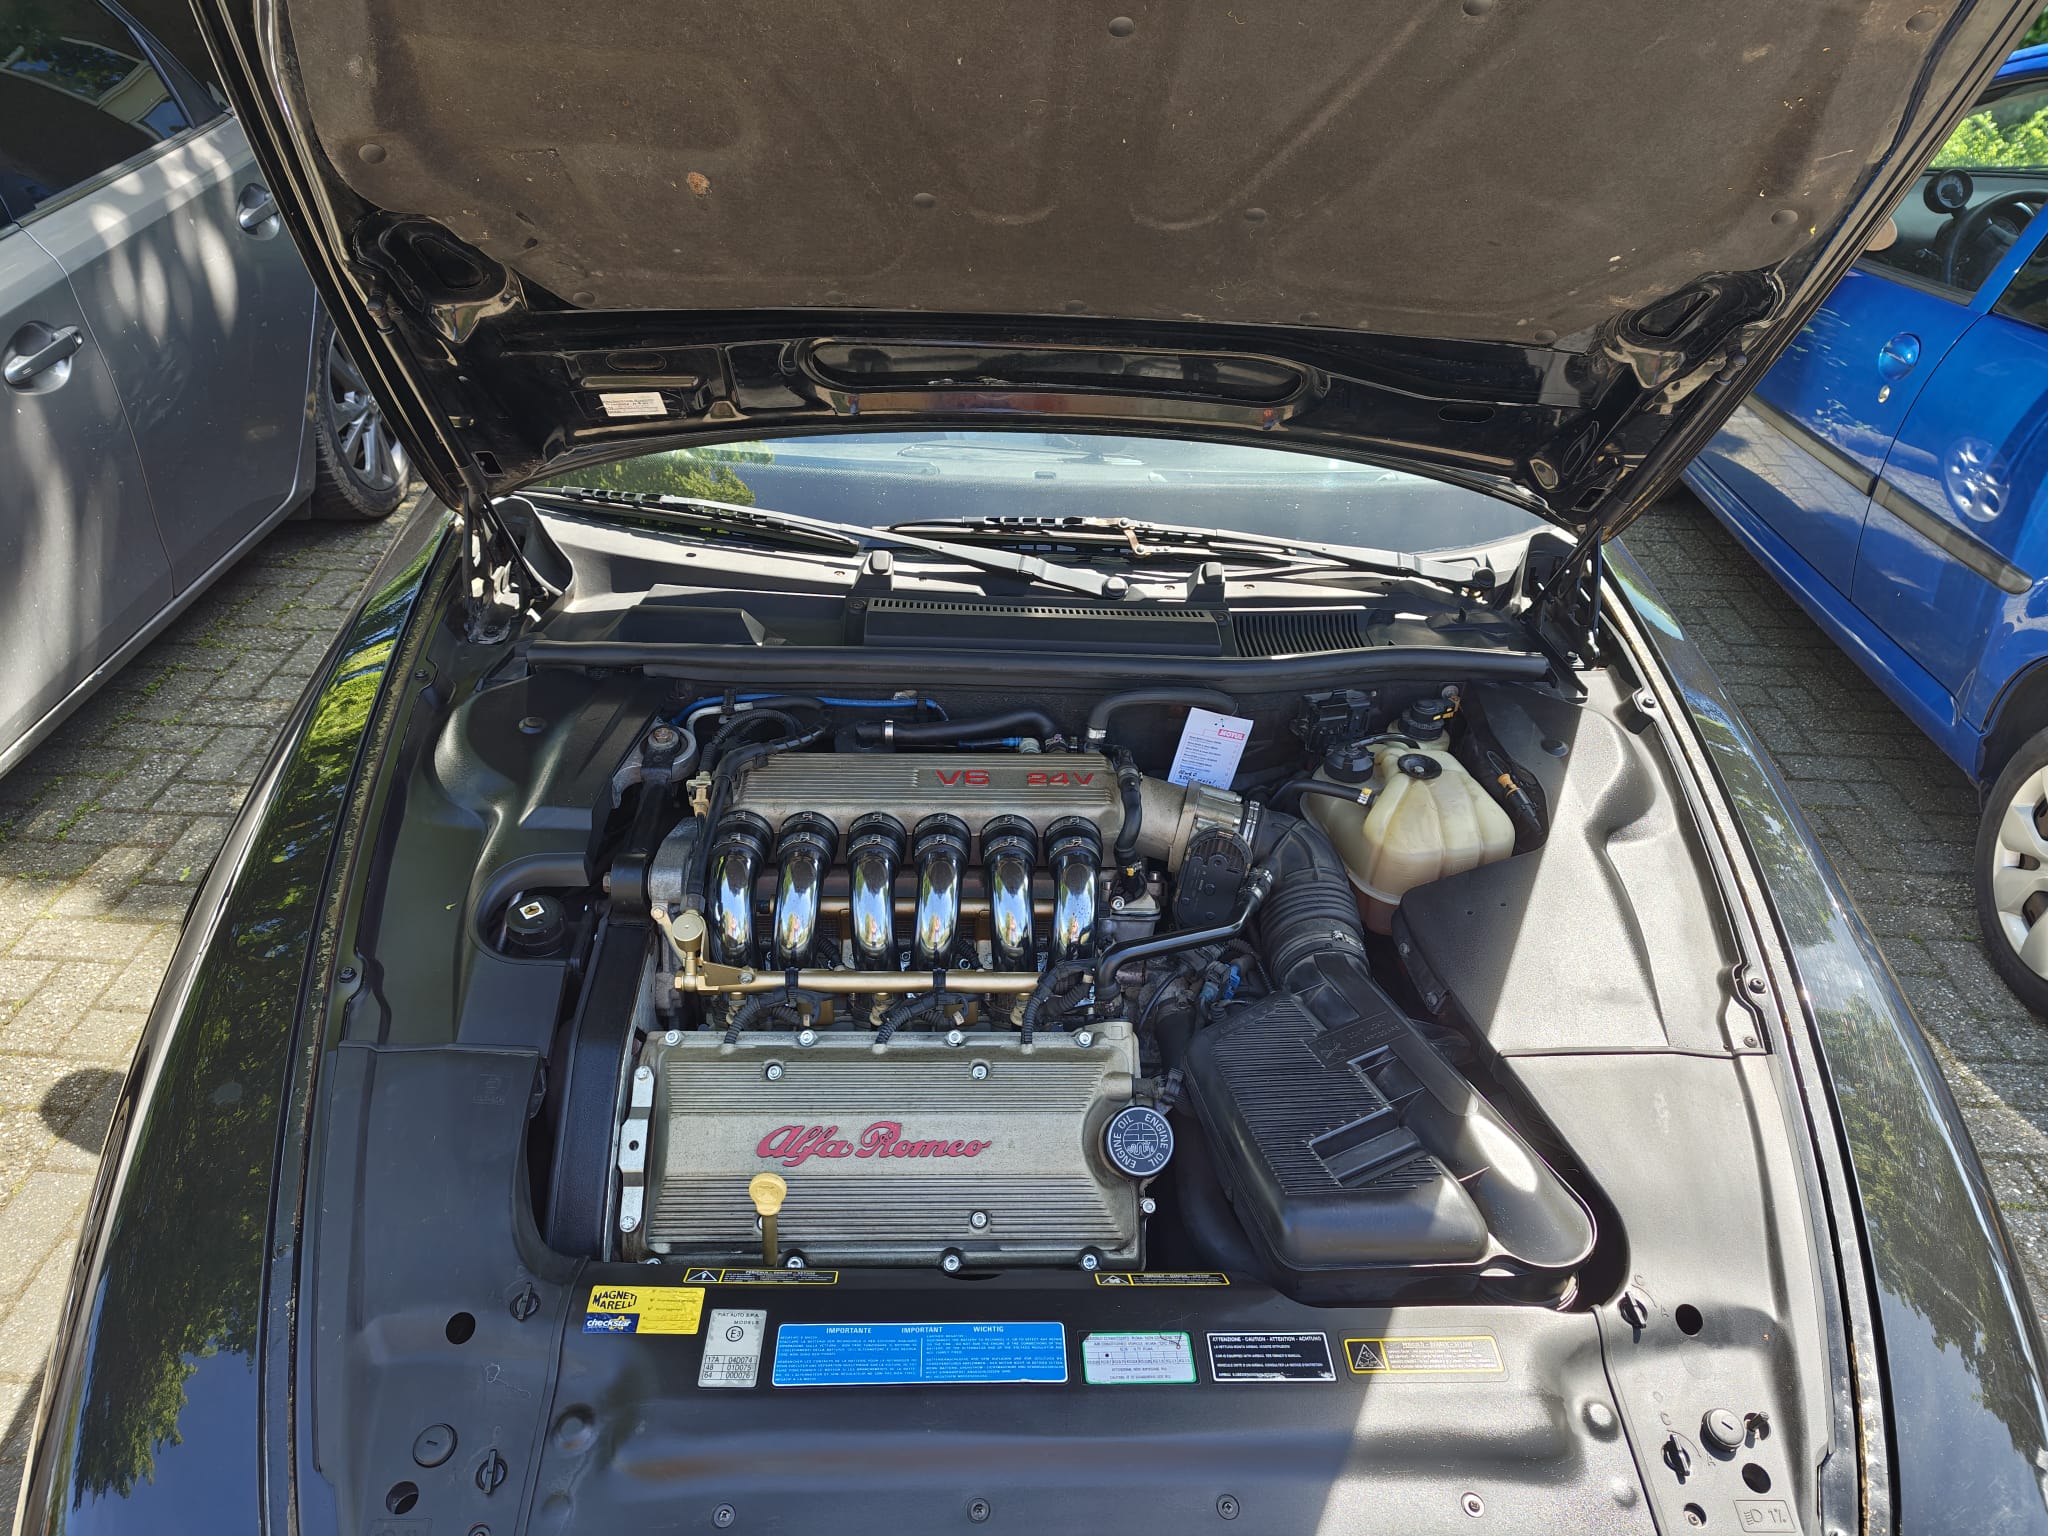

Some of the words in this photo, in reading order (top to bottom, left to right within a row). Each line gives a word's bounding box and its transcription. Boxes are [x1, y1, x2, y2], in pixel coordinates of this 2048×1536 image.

[1220, 730, 1244, 740] MOTUL
[935, 769, 990, 787] V6
[1026, 771, 1095, 787] 24V
[1117, 1114, 1134, 1130] OIL
[1144, 1113, 1169, 1149] ENGINE
[756, 1125, 854, 1167] Alfa
[855, 1120, 992, 1159] Romeo
[1113, 1132, 1137, 1169] ENGINE
[1148, 1152, 1164, 1167] OIL
[586, 1318, 633, 1328] checkstar
[973, 1325, 1004, 1333] WICHTIG
